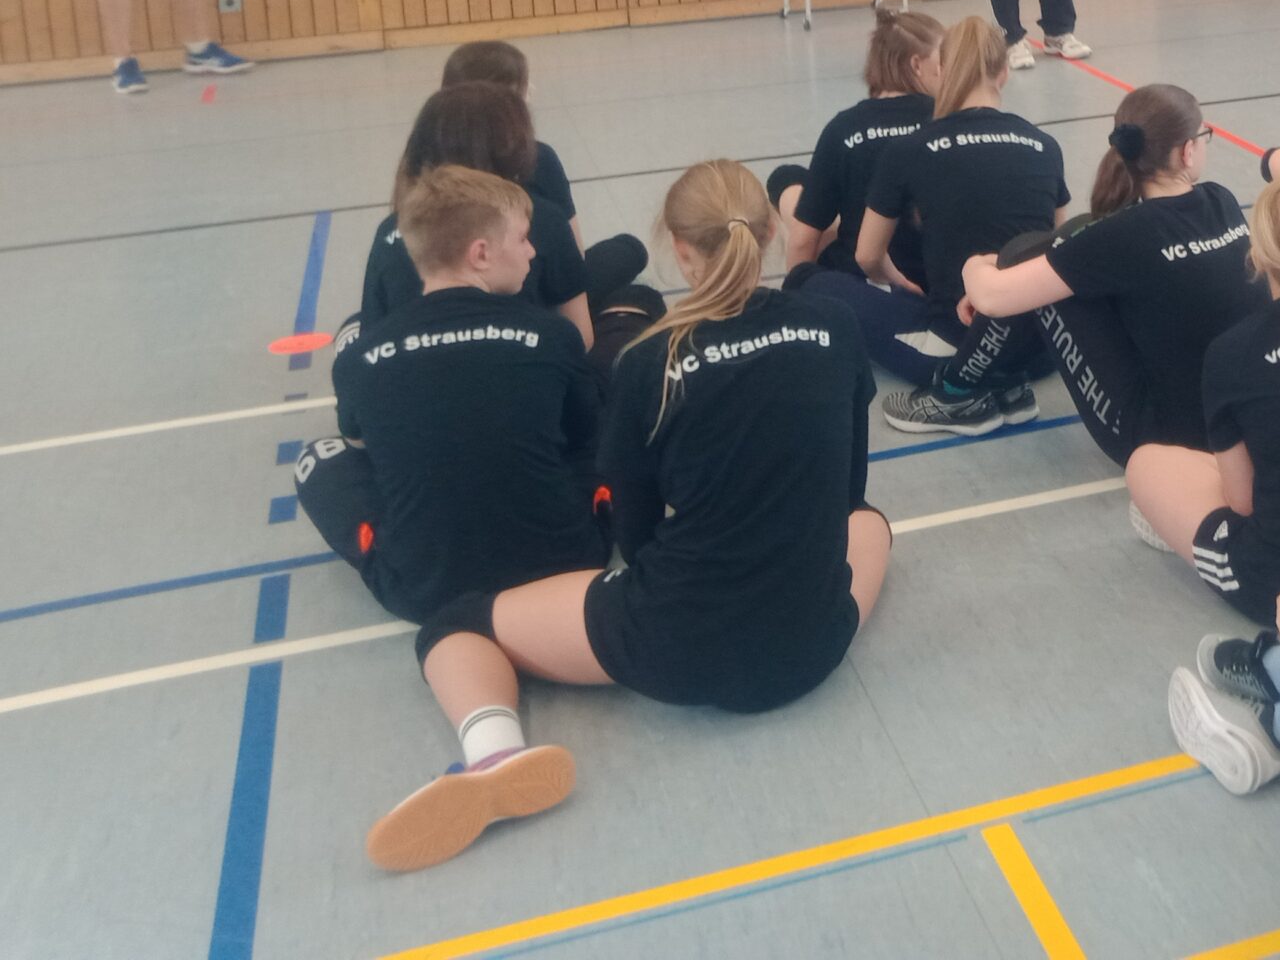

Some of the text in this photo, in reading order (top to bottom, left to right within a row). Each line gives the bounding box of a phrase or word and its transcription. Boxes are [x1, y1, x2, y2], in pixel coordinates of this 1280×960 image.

[844, 132, 864, 149] VC
[926, 132, 1044, 153] VC Strausberg
[1161, 244, 1188, 262] VC
[363, 324, 540, 365] VC Strausberg
[668, 325, 831, 381] VC Strausberg
[1077, 365, 1112, 426] THE
